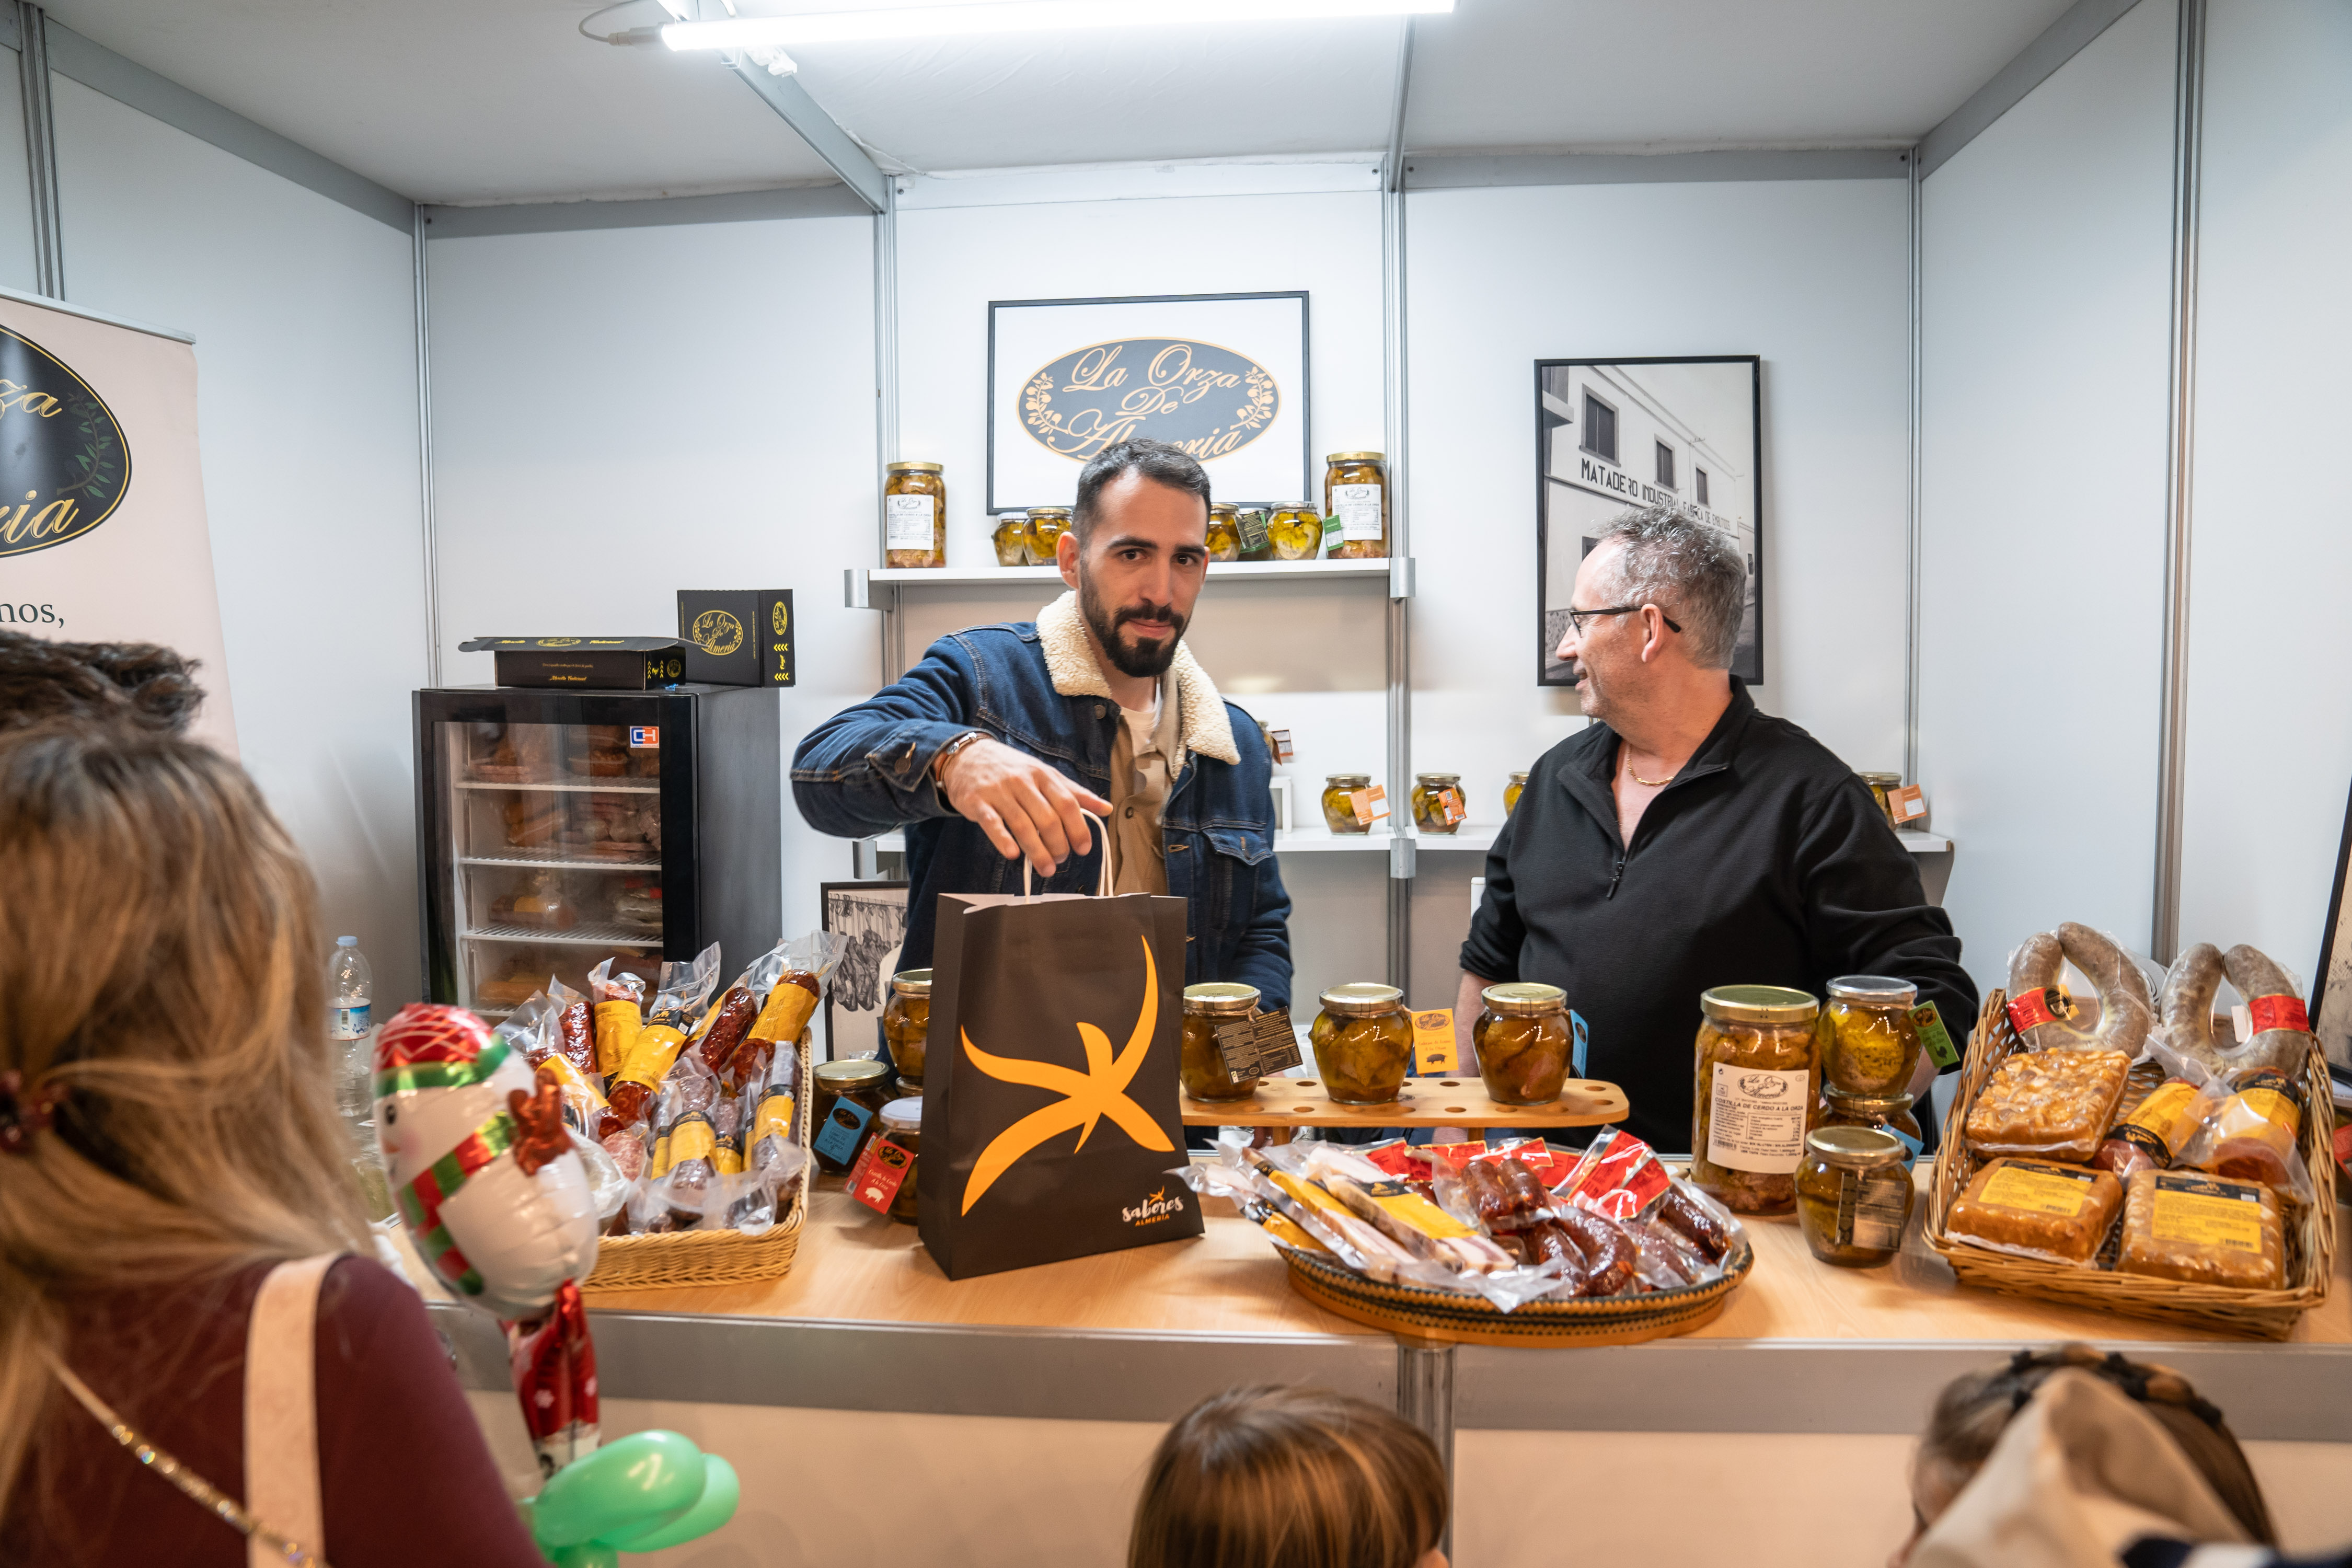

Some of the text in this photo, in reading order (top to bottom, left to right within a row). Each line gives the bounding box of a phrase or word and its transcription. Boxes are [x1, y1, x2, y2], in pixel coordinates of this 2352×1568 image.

[1062, 343, 1242, 404] La Orza
[1115, 386, 1184, 416] De
[1581, 458, 1638, 497] MATADERO
[701, 613, 713, 628] La
[717, 613, 734, 635] Orza
[1715, 1097, 1741, 1107] COSTILLA
[1122, 1196, 1184, 1222] sabores
